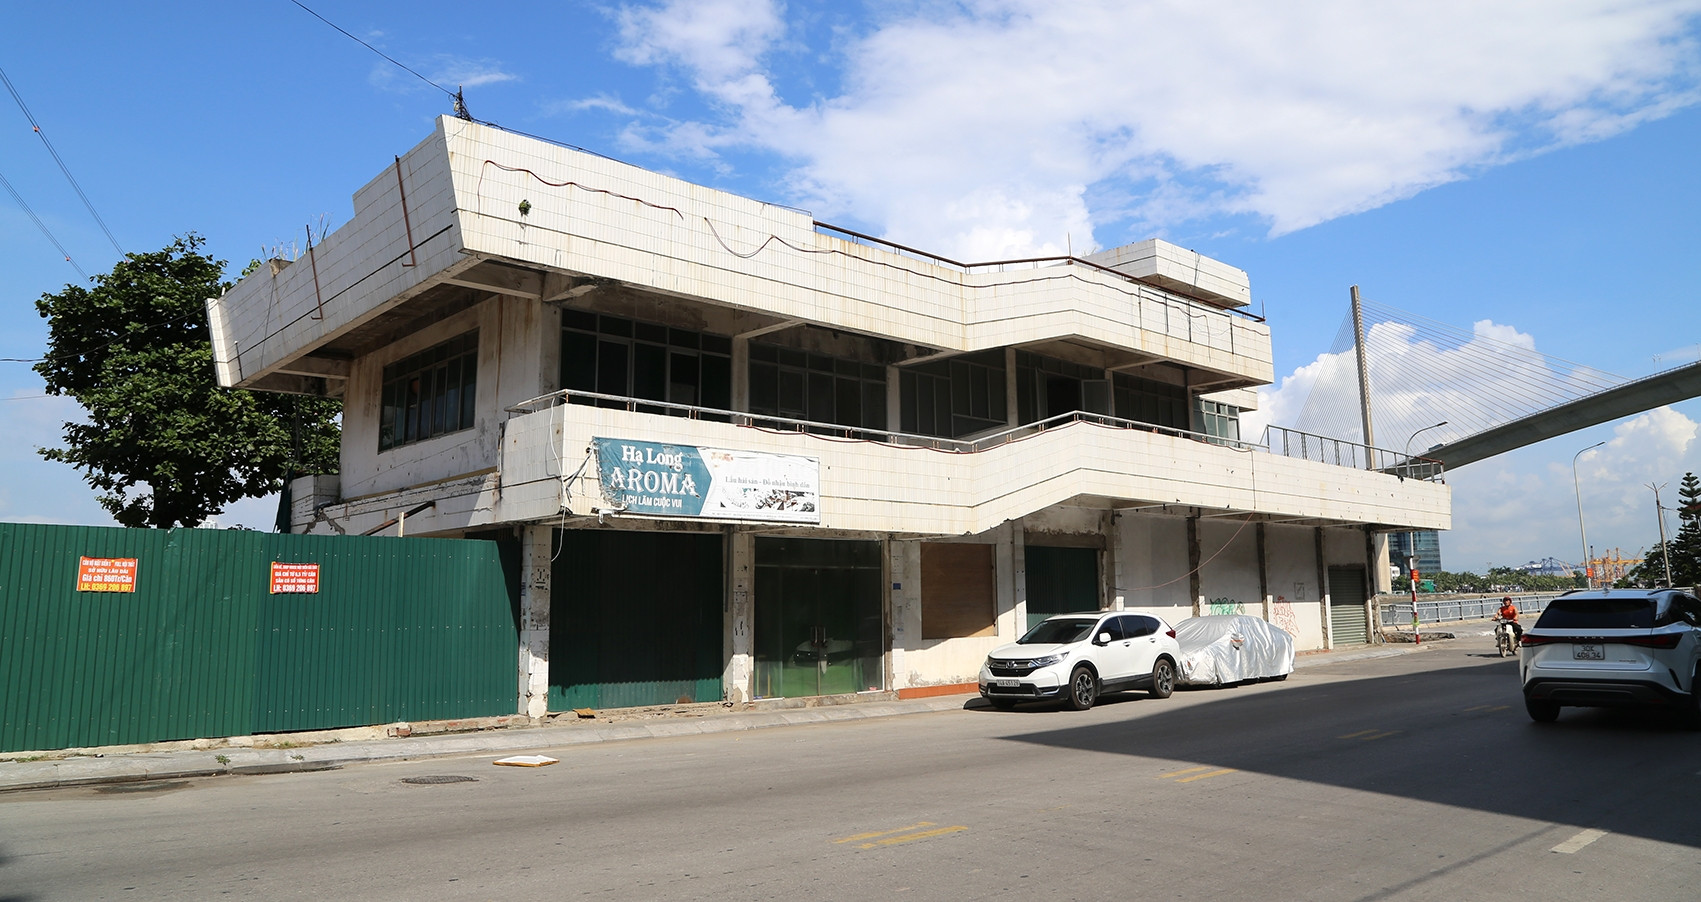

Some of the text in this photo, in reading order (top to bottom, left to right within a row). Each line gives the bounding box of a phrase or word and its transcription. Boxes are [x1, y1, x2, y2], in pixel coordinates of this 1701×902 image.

[621, 445, 644, 466] Hạ
[646, 447, 684, 472] Long
[609, 466, 698, 497] AROMA
[622, 494, 637, 506] LỊCH
[653, 496, 671, 508] CUỘC
[671, 498, 683, 508] VUI
[82, 574, 92, 582] Giá
